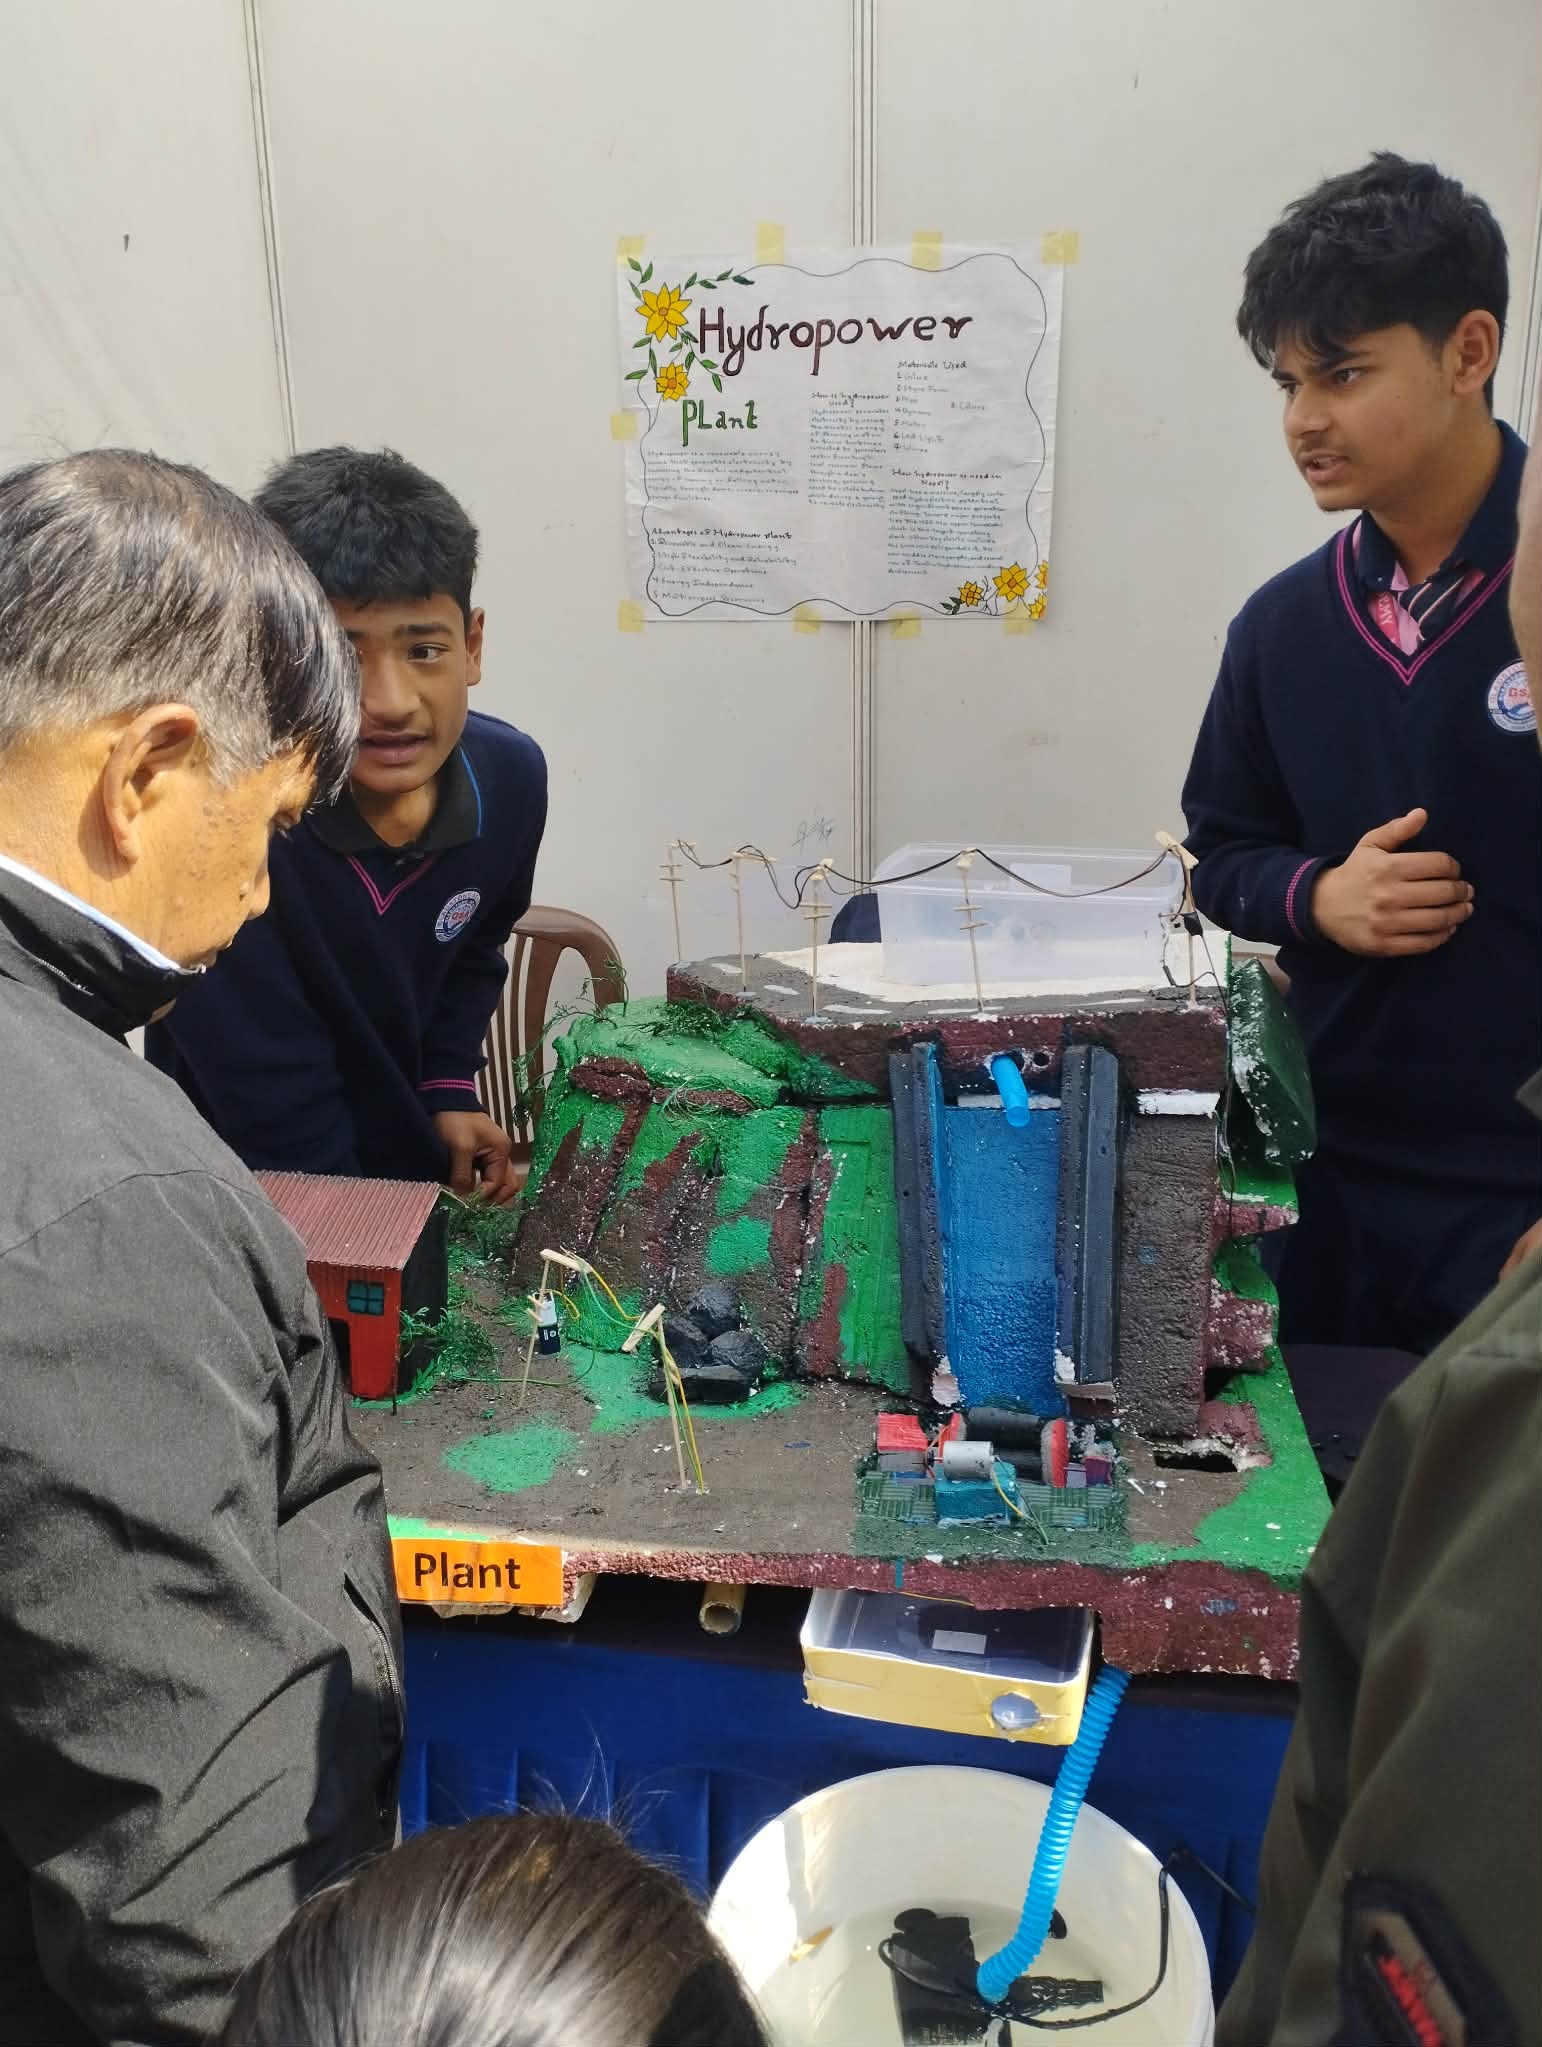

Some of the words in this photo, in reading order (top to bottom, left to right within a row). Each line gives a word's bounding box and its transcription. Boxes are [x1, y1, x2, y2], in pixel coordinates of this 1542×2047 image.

[699, 304, 973, 376] Hydropower
[943, 360, 967, 370] Used
[414, 1552, 521, 1590] Plant
